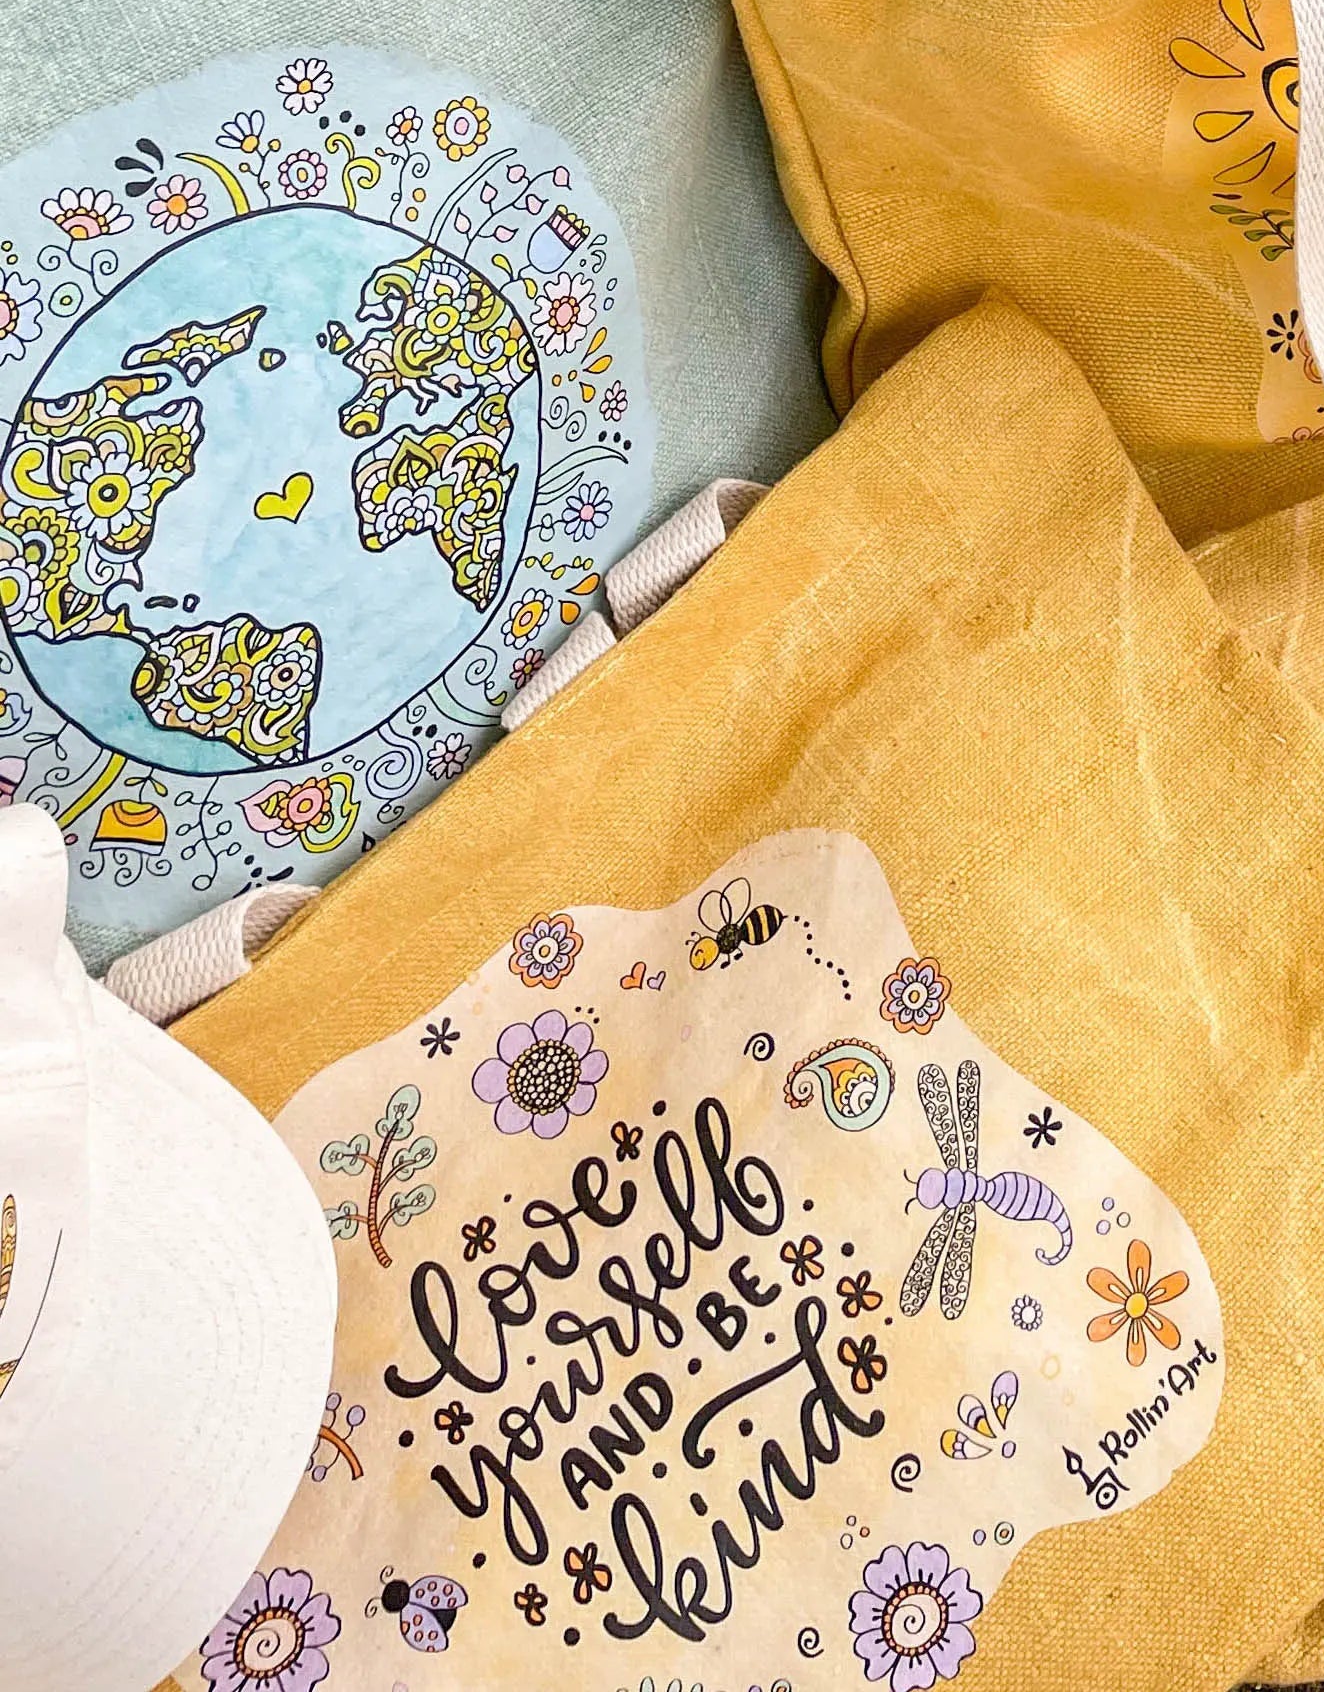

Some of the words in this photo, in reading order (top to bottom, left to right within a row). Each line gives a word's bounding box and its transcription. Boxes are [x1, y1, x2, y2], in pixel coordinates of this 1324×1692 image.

[385, 1156, 636, 1397] love
[431, 1097, 784, 1566] yourself
[561, 1373, 673, 1509] AND
[696, 1256, 781, 1351] BE
[602, 1295, 885, 1641] kind
